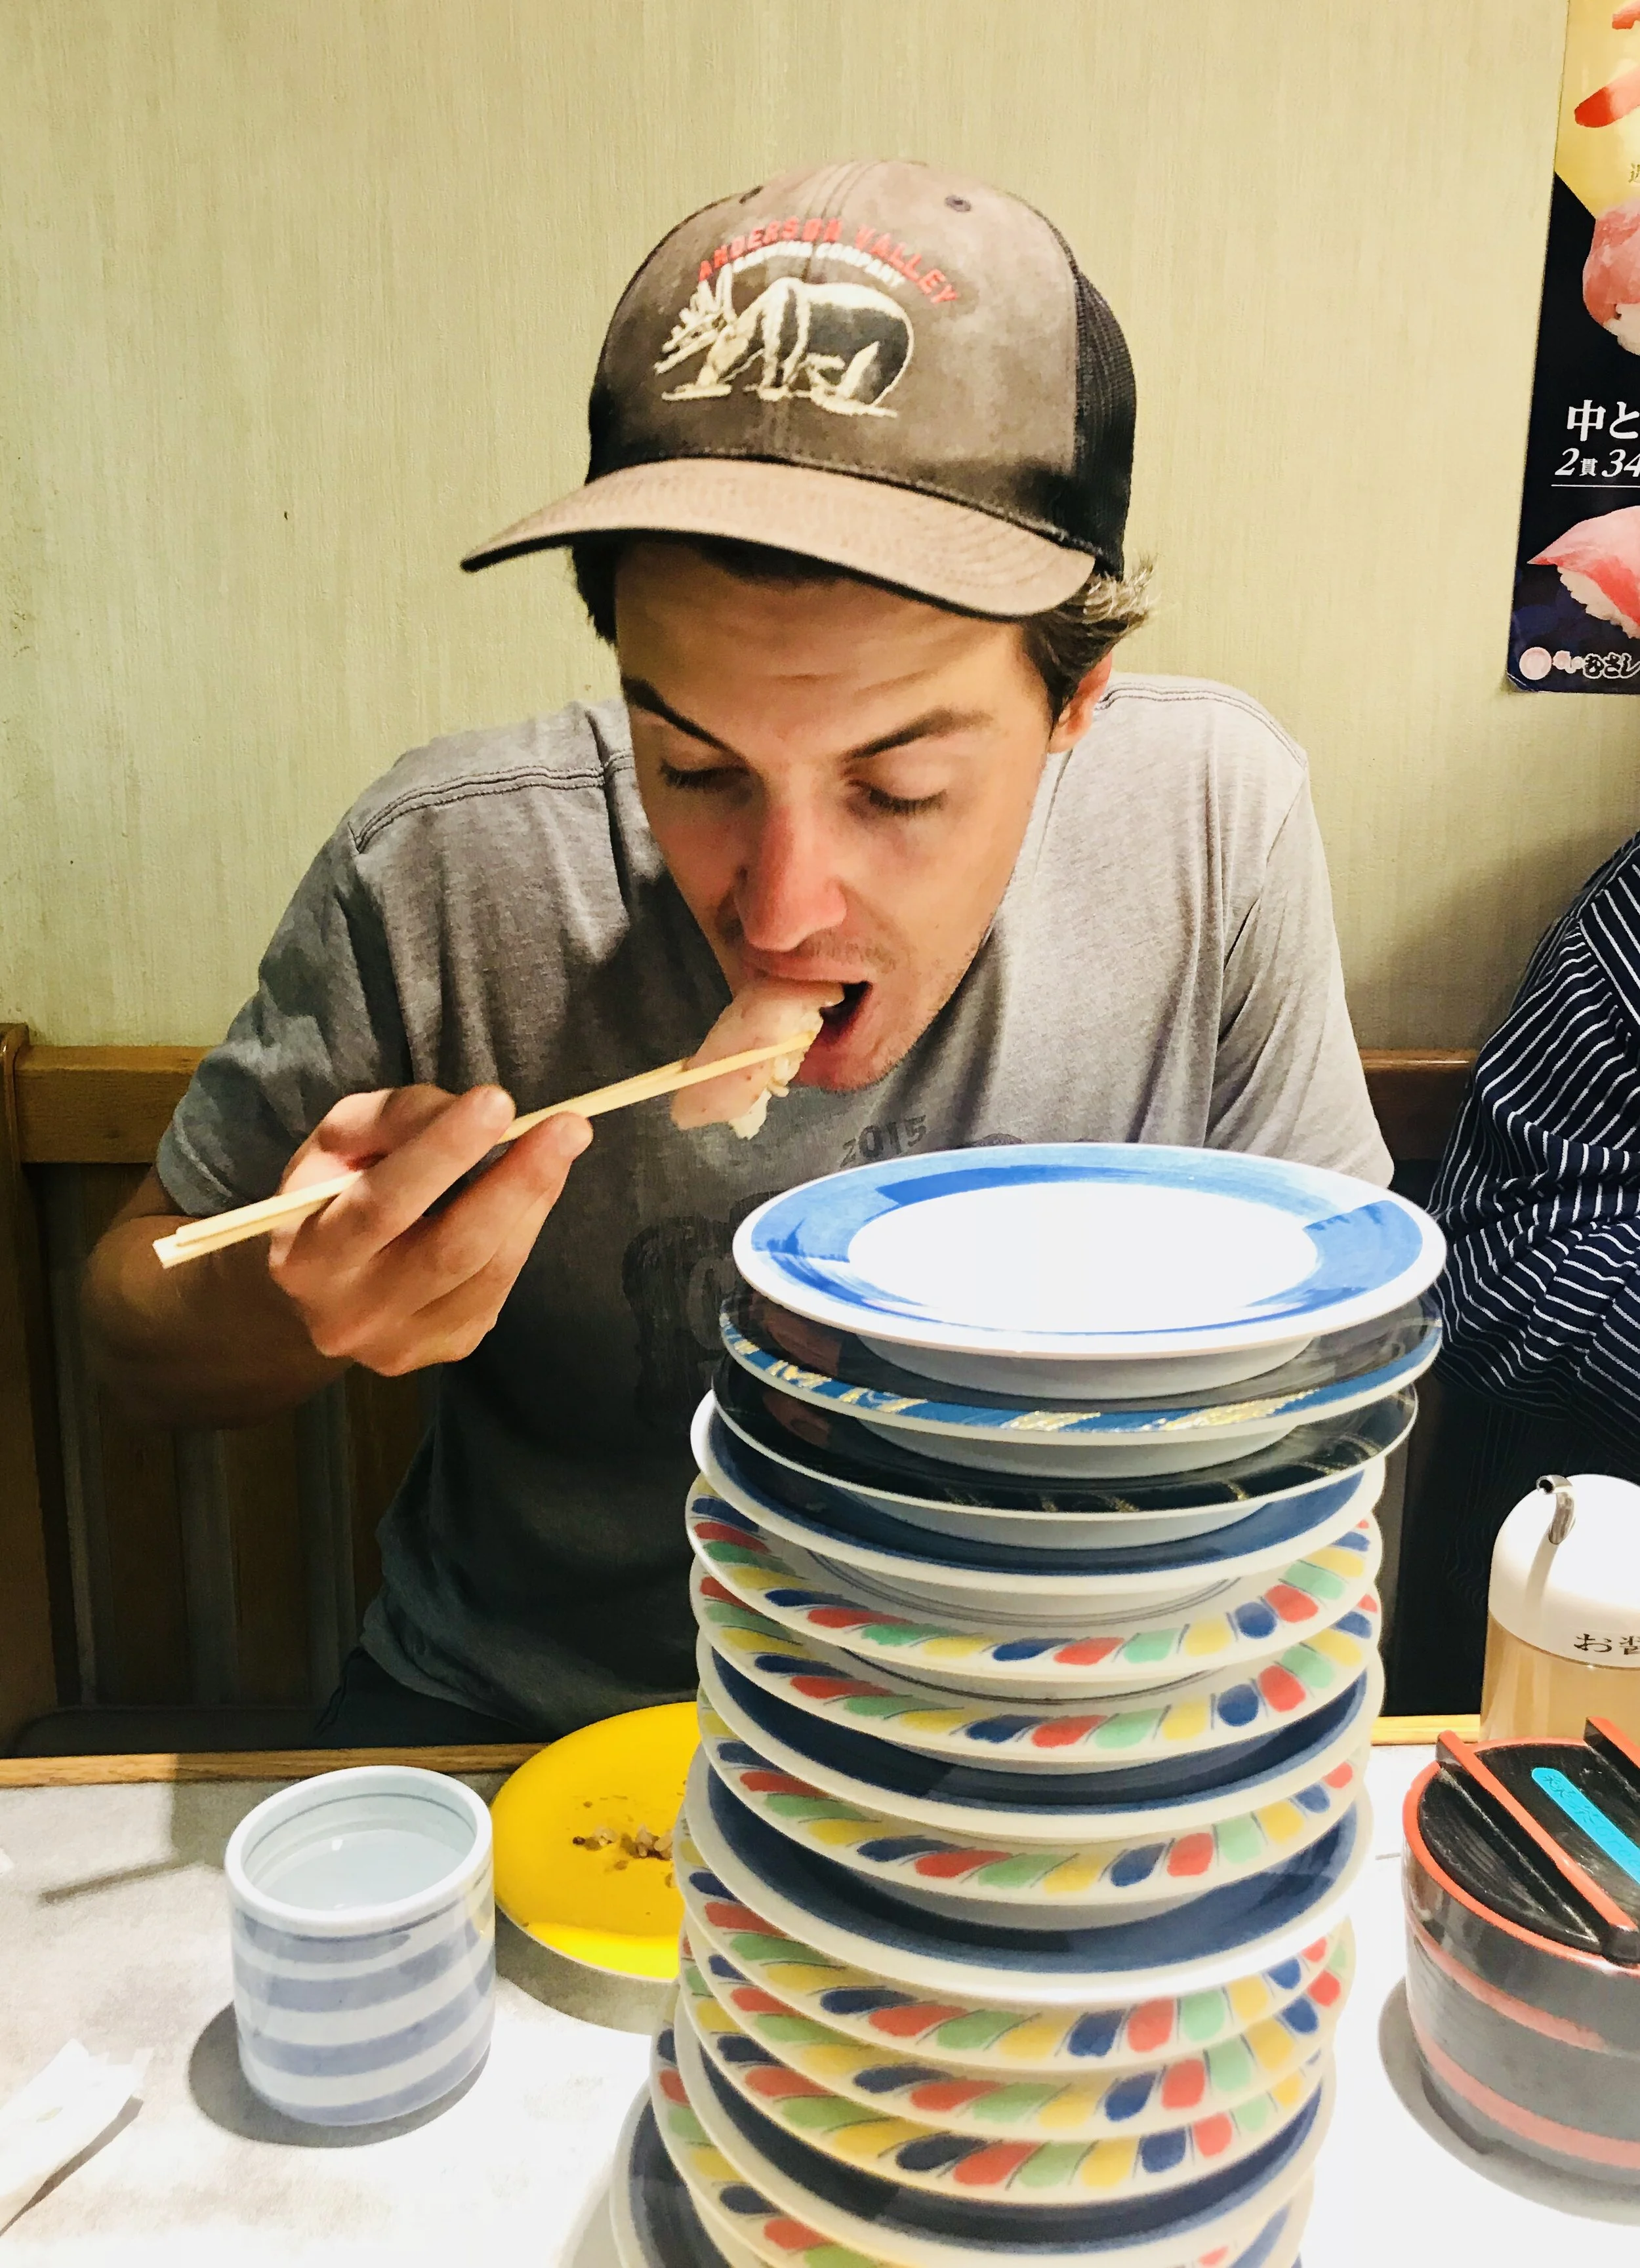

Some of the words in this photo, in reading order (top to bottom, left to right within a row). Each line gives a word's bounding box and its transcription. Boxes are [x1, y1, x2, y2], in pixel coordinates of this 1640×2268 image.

[699, 216, 843, 281] ANDERSON
[855, 224, 958, 304] VALLEY
[1567, 399, 1640, 441] 中と
[840, 1114, 926, 1167] 2015
